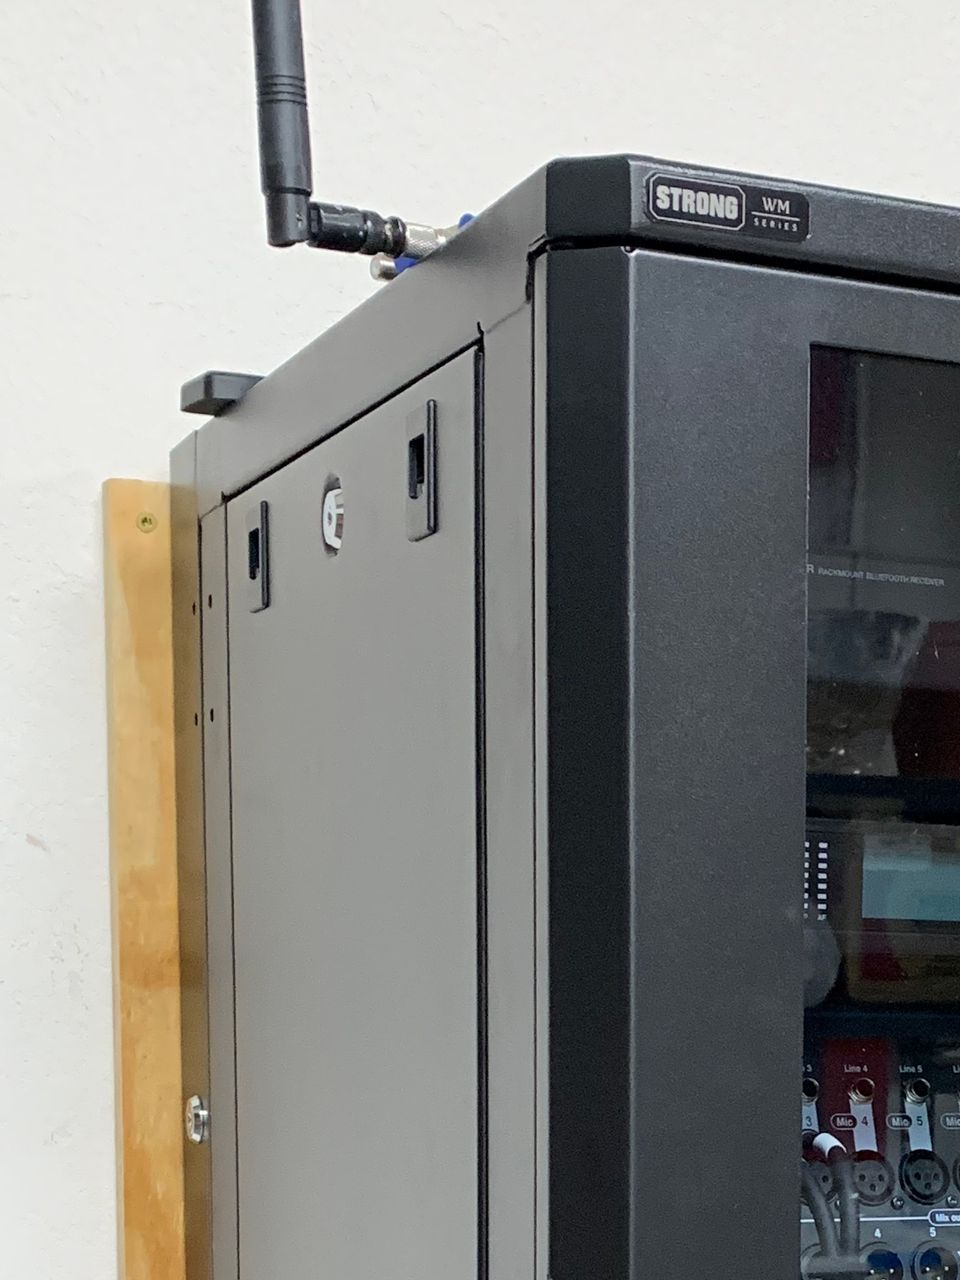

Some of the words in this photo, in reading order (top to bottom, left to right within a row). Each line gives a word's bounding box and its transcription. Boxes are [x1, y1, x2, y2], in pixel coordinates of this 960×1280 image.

[656, 185, 738, 220] STRONG
[762, 197, 790, 214] WM
[754, 217, 797, 232] SERIES
[844, 1064, 861, 1073] Line
[899, 1064, 916, 1073] Line
[806, 1115, 814, 1127] 3
[836, 1116, 854, 1127] Mic
[861, 1115, 869, 1127] 4
[891, 1116, 910, 1127] Mic
[916, 1115, 923, 1127] 5
[935, 1213, 950, 1222] Mix
[875, 1229, 881, 1238] 4
[930, 1227, 937, 1237] 5
